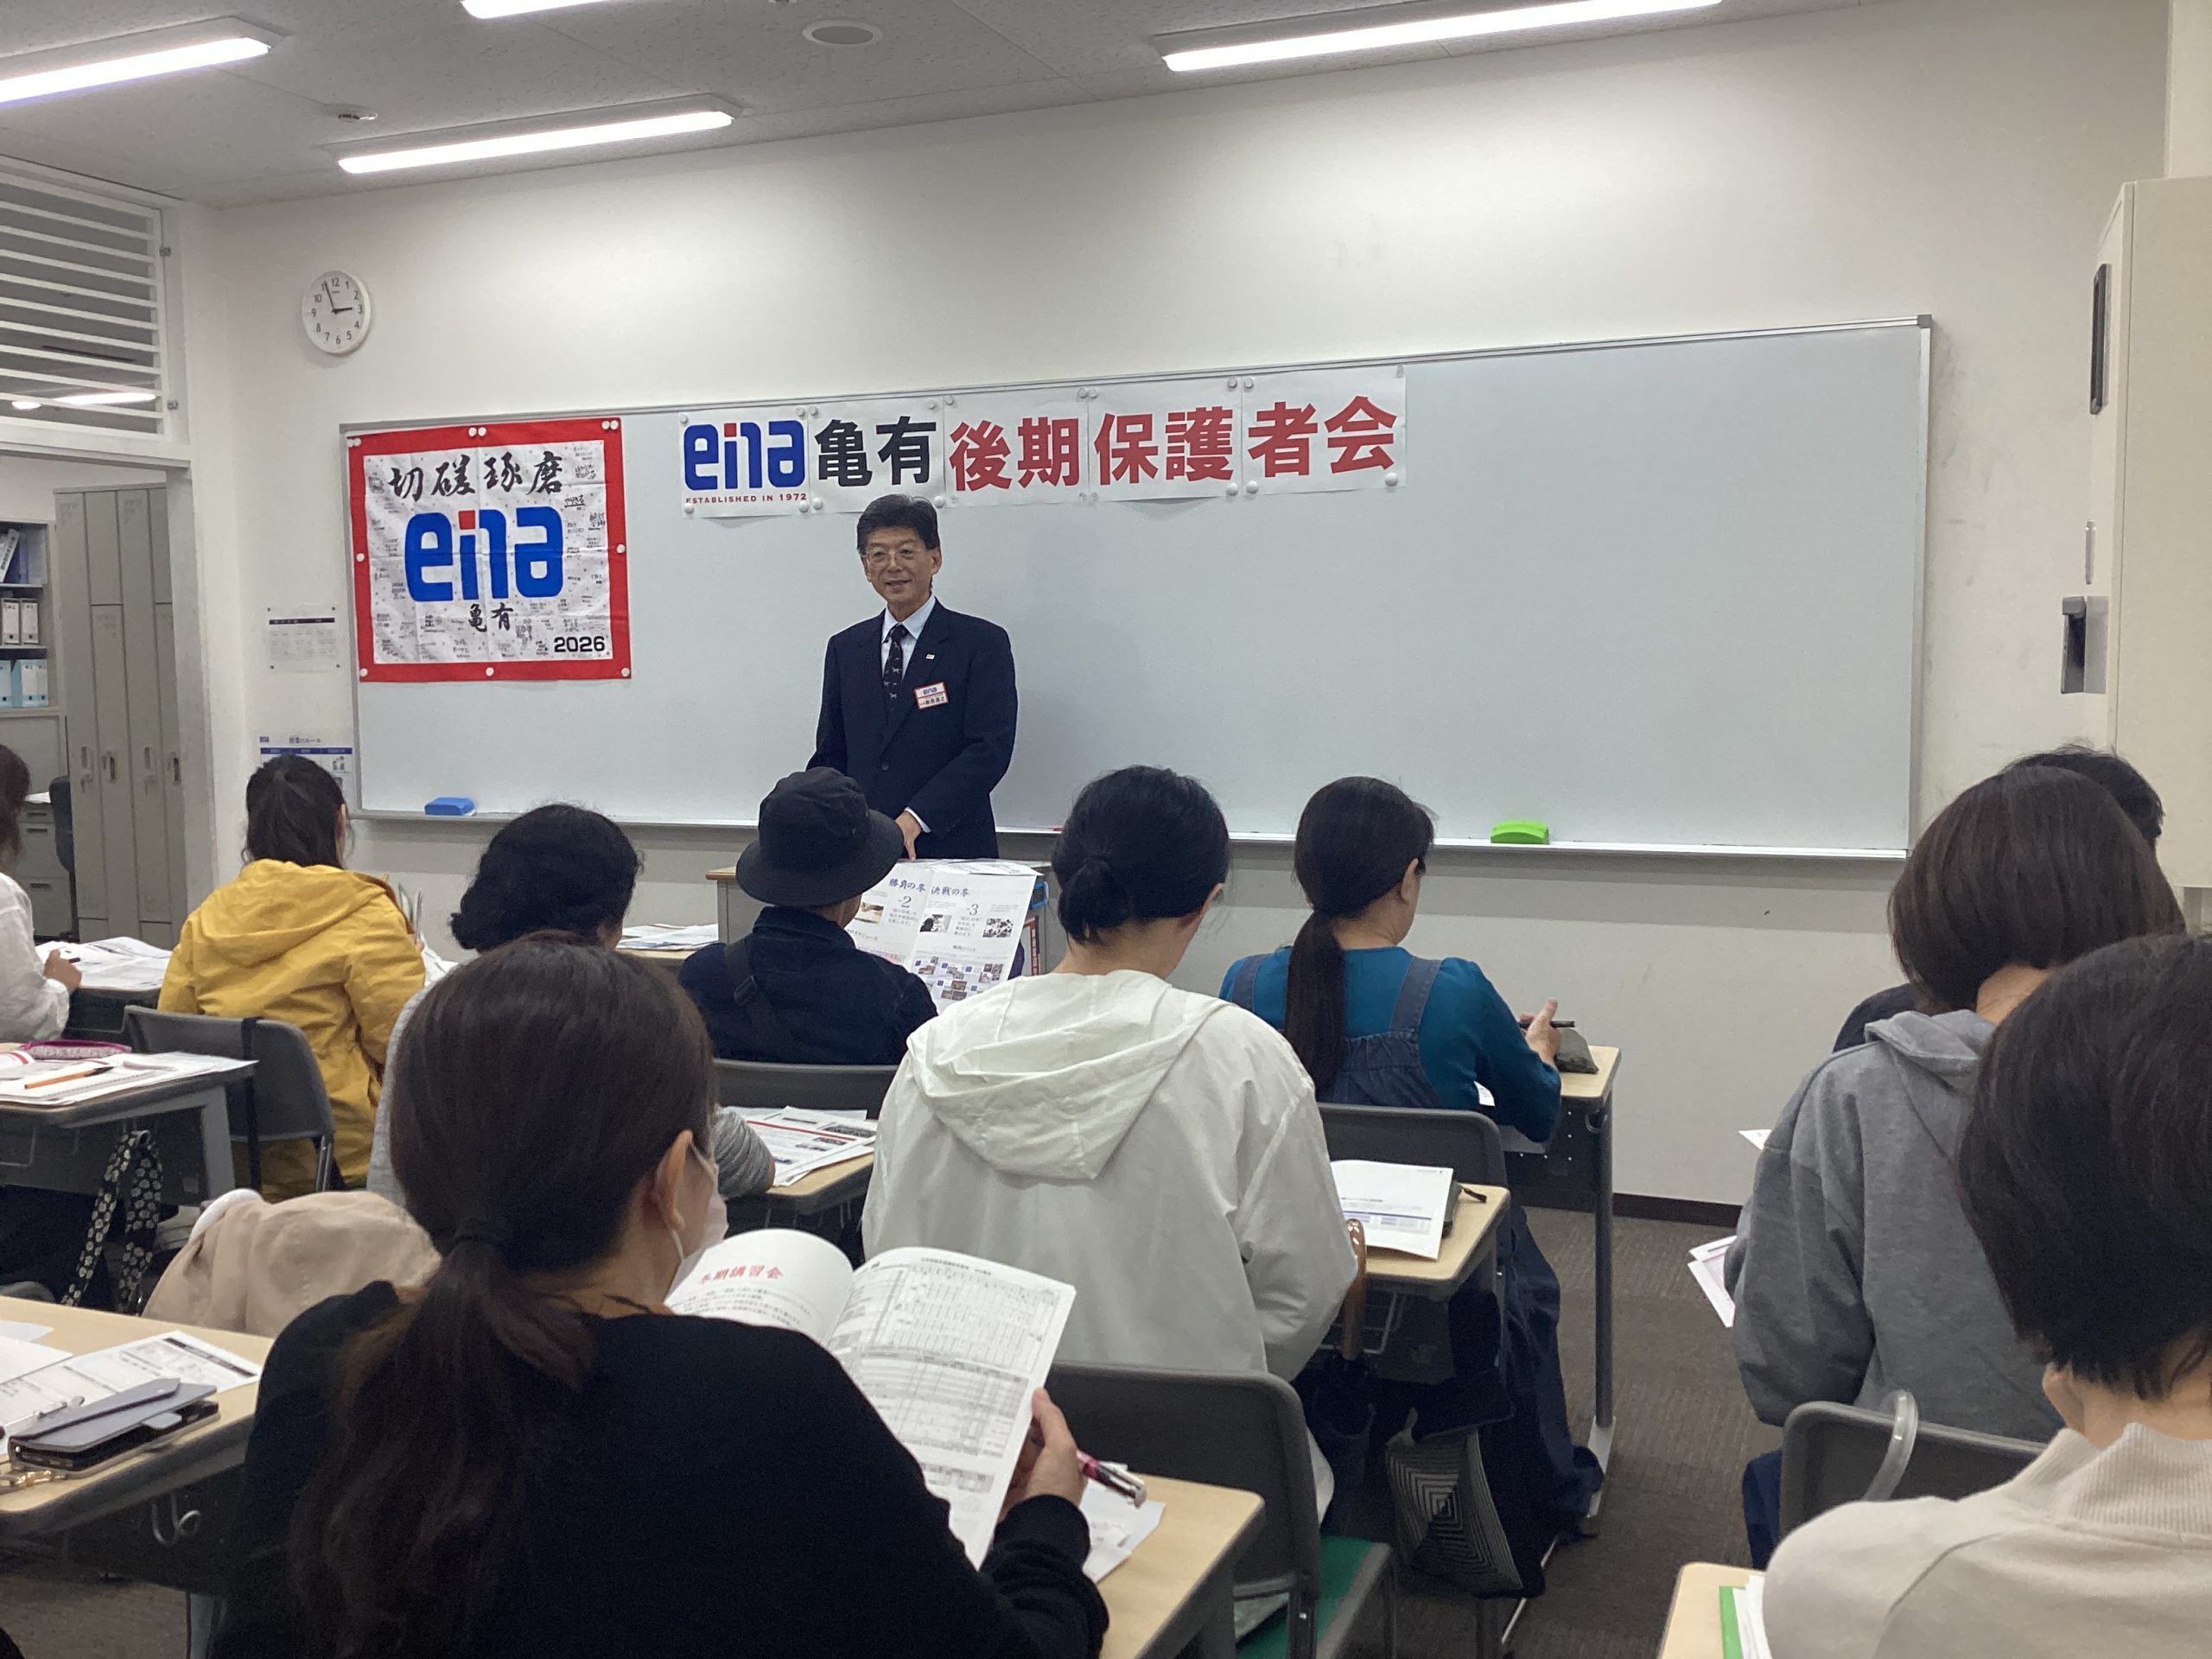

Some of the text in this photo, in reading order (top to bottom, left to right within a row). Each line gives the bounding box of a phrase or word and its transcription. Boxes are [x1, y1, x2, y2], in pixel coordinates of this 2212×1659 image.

[332, 277, 340, 287] 12
[314, 294, 322, 303] 10
[353, 290, 359, 300] 2
[311, 308, 316, 317] 9
[358, 304, 363, 314] 3
[316, 322, 321, 333] 8
[354, 321, 359, 329] 4
[325, 332, 330, 341] 7
[335, 335, 341, 345] 6
[346, 330, 352, 340] 5
[684, 420, 805, 491] ena
[389, 450, 563, 502] 切磋琢磨
[686, 495, 757, 504] ESTABLISHED
[404, 505, 563, 602] ena
[468, 602, 514, 632] 亀有
[554, 636, 606, 653] 2026
[888, 878, 926, 892] 勝負の冬
[931, 886, 969, 897] 決戦の冬
